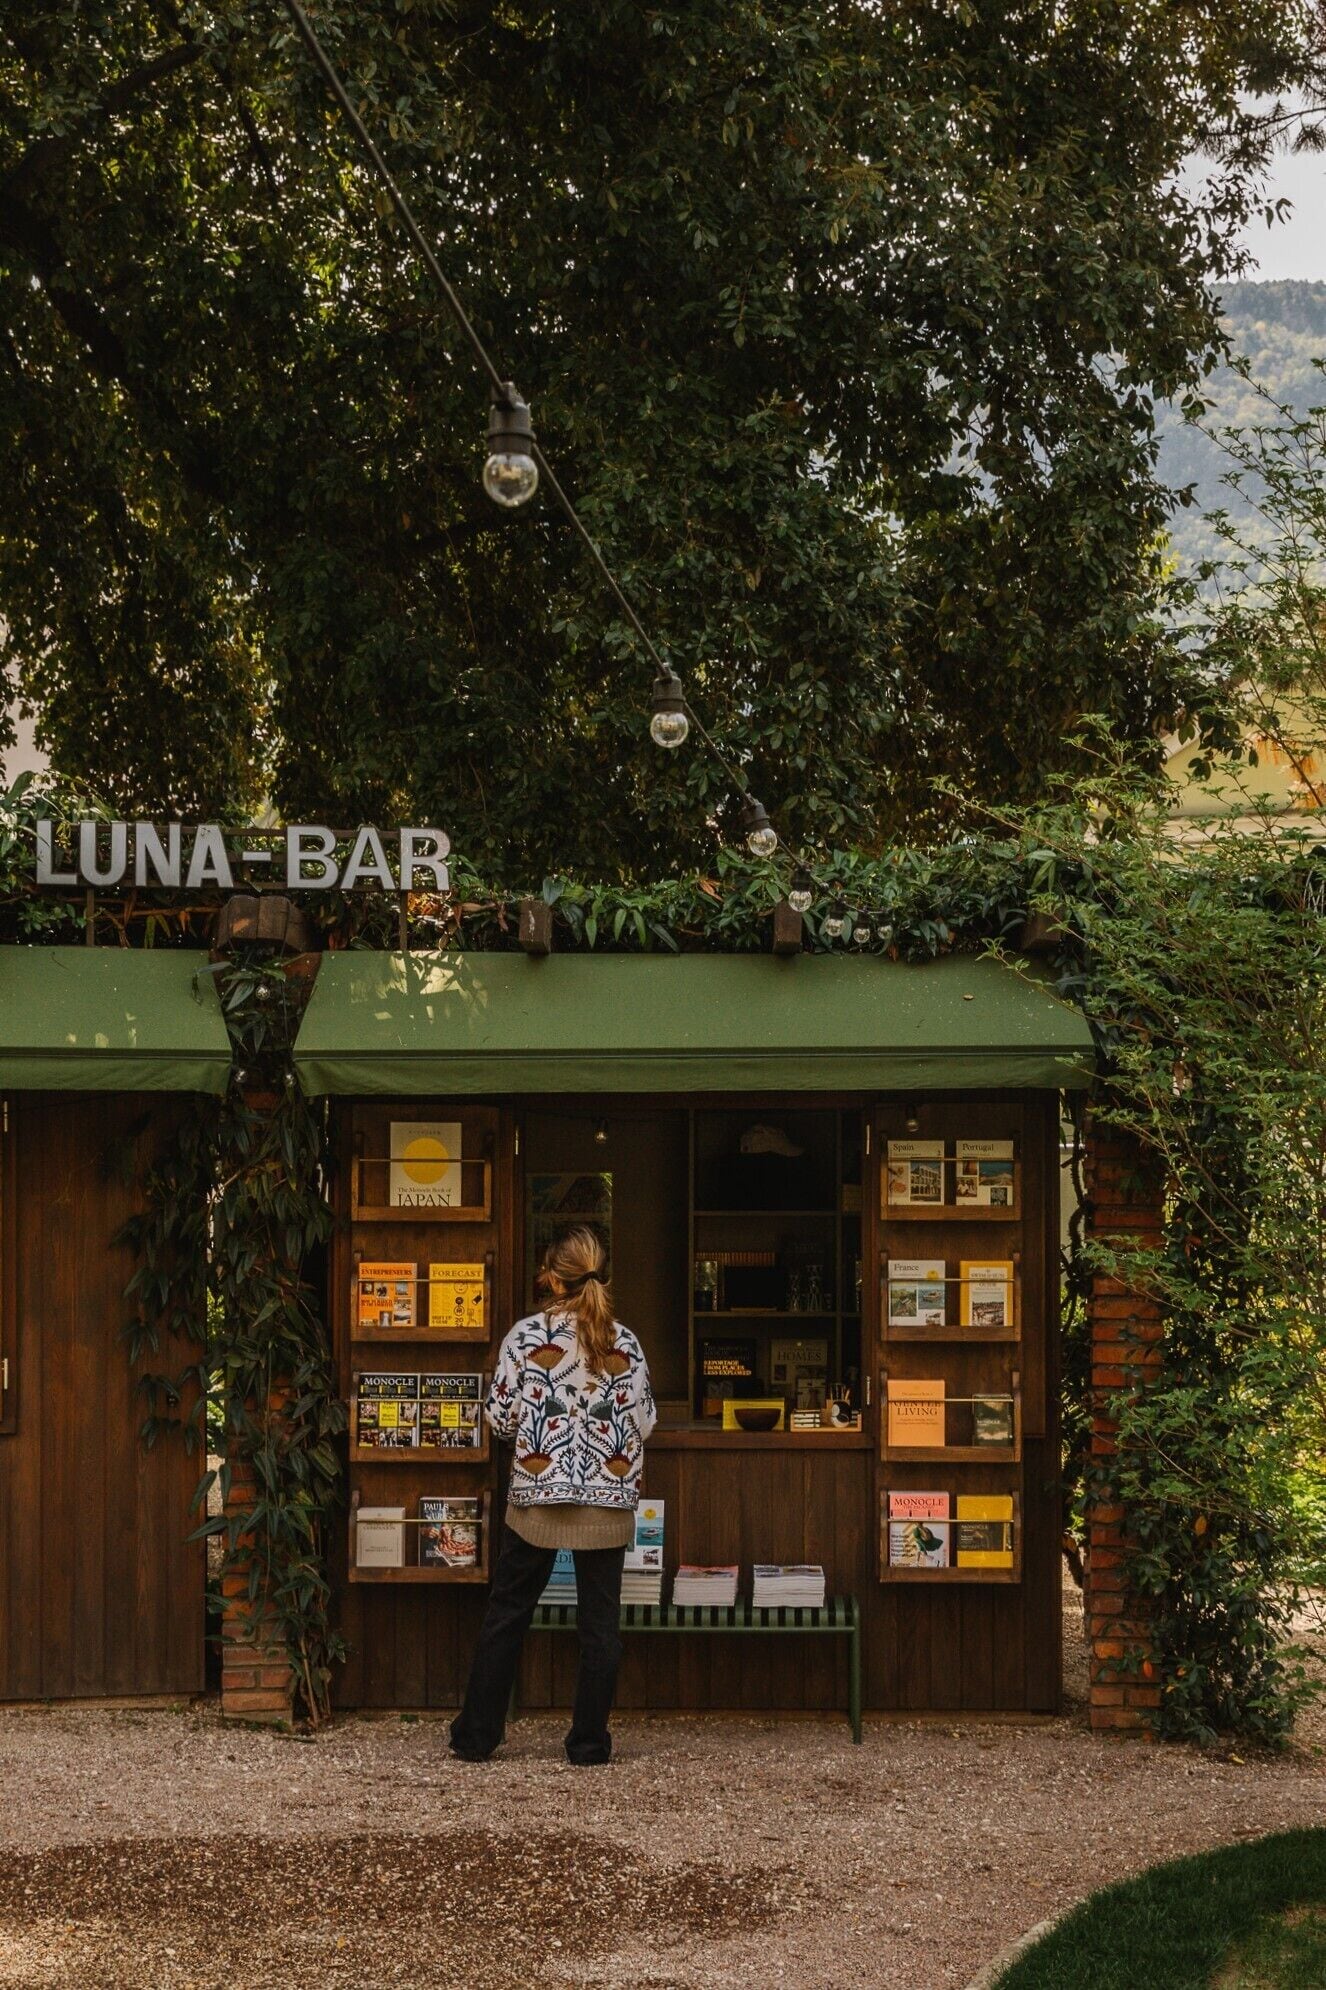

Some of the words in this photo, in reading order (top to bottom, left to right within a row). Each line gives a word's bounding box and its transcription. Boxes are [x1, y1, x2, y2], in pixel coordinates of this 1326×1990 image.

[893, 1143, 914, 1152] Spain
[962, 1143, 994, 1152] Portugal
[398, 1193, 451, 1207] JAPAN
[894, 1263, 920, 1271] France
[432, 1270, 482, 1278] FORECAST
[364, 1377, 414, 1386] MONOCLE
[425, 1378, 475, 1387] MONOCLE
[897, 1407, 938, 1416] LIVING
[894, 1498, 944, 1507] MONOCLE
